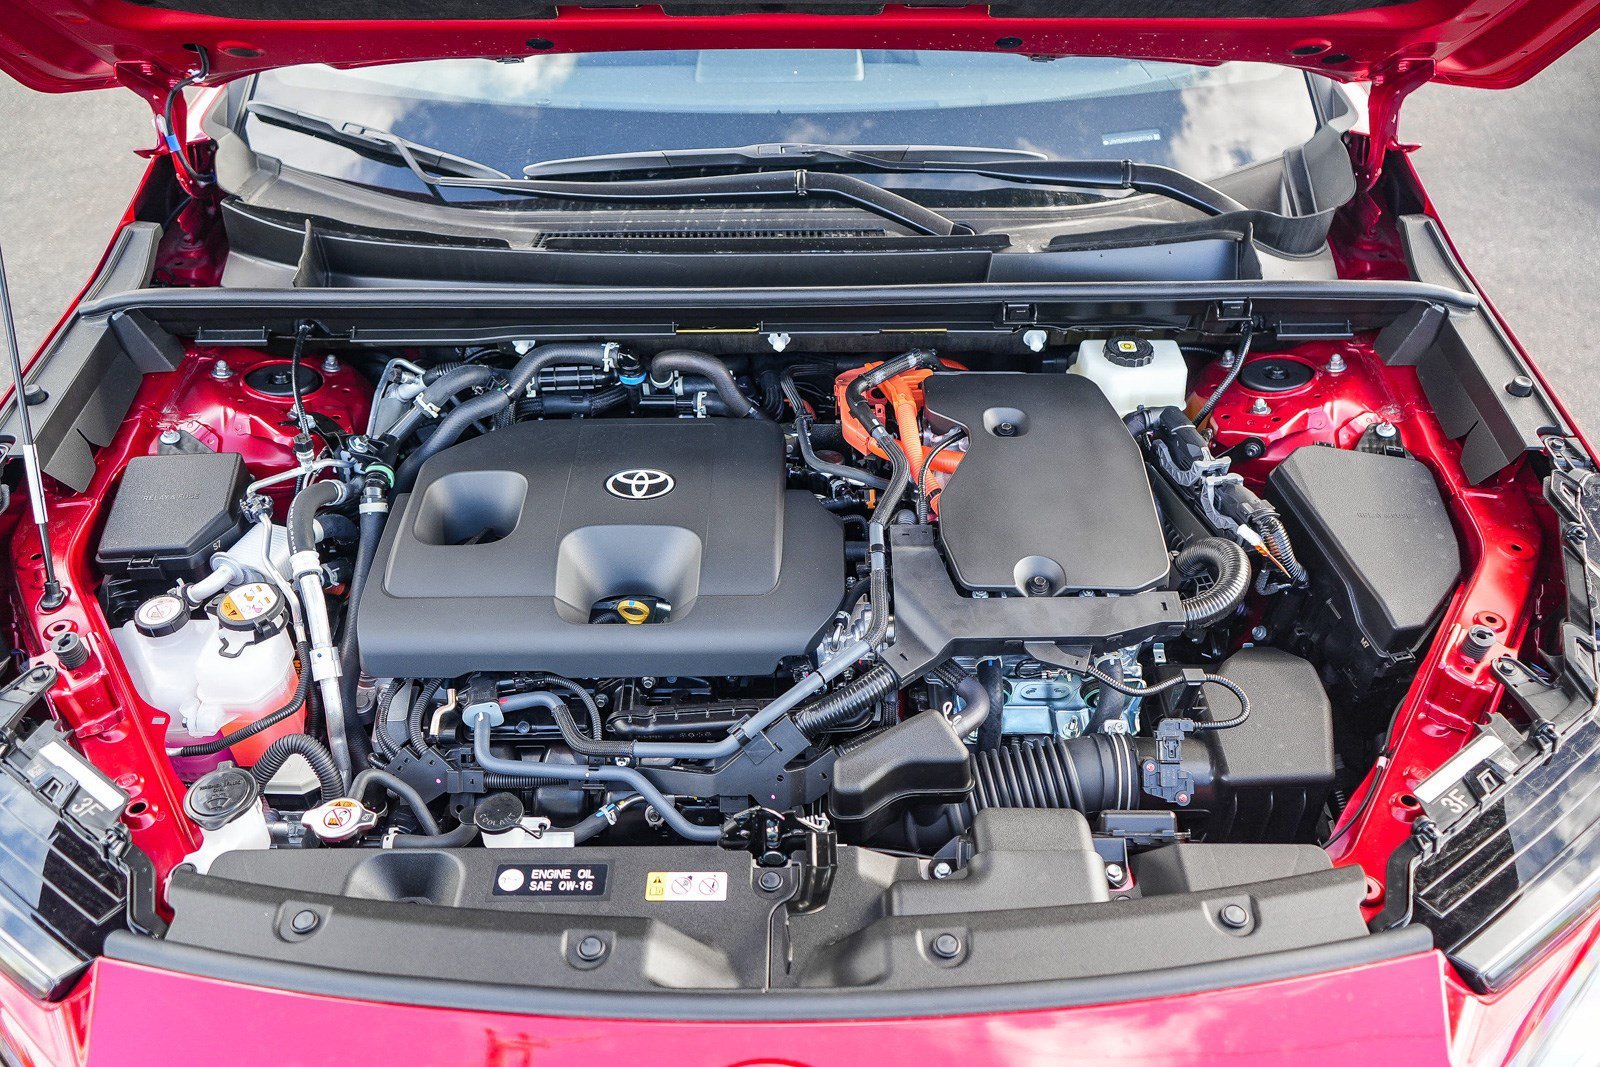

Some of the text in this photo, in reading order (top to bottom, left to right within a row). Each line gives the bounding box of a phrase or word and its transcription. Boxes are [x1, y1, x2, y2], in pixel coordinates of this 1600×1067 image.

[71, 797, 105, 817] 3F
[1441, 789, 1469, 814] 3F
[530, 869, 595, 880] ENGINE OIL
[529, 881, 593, 891] SAE 0W-16
